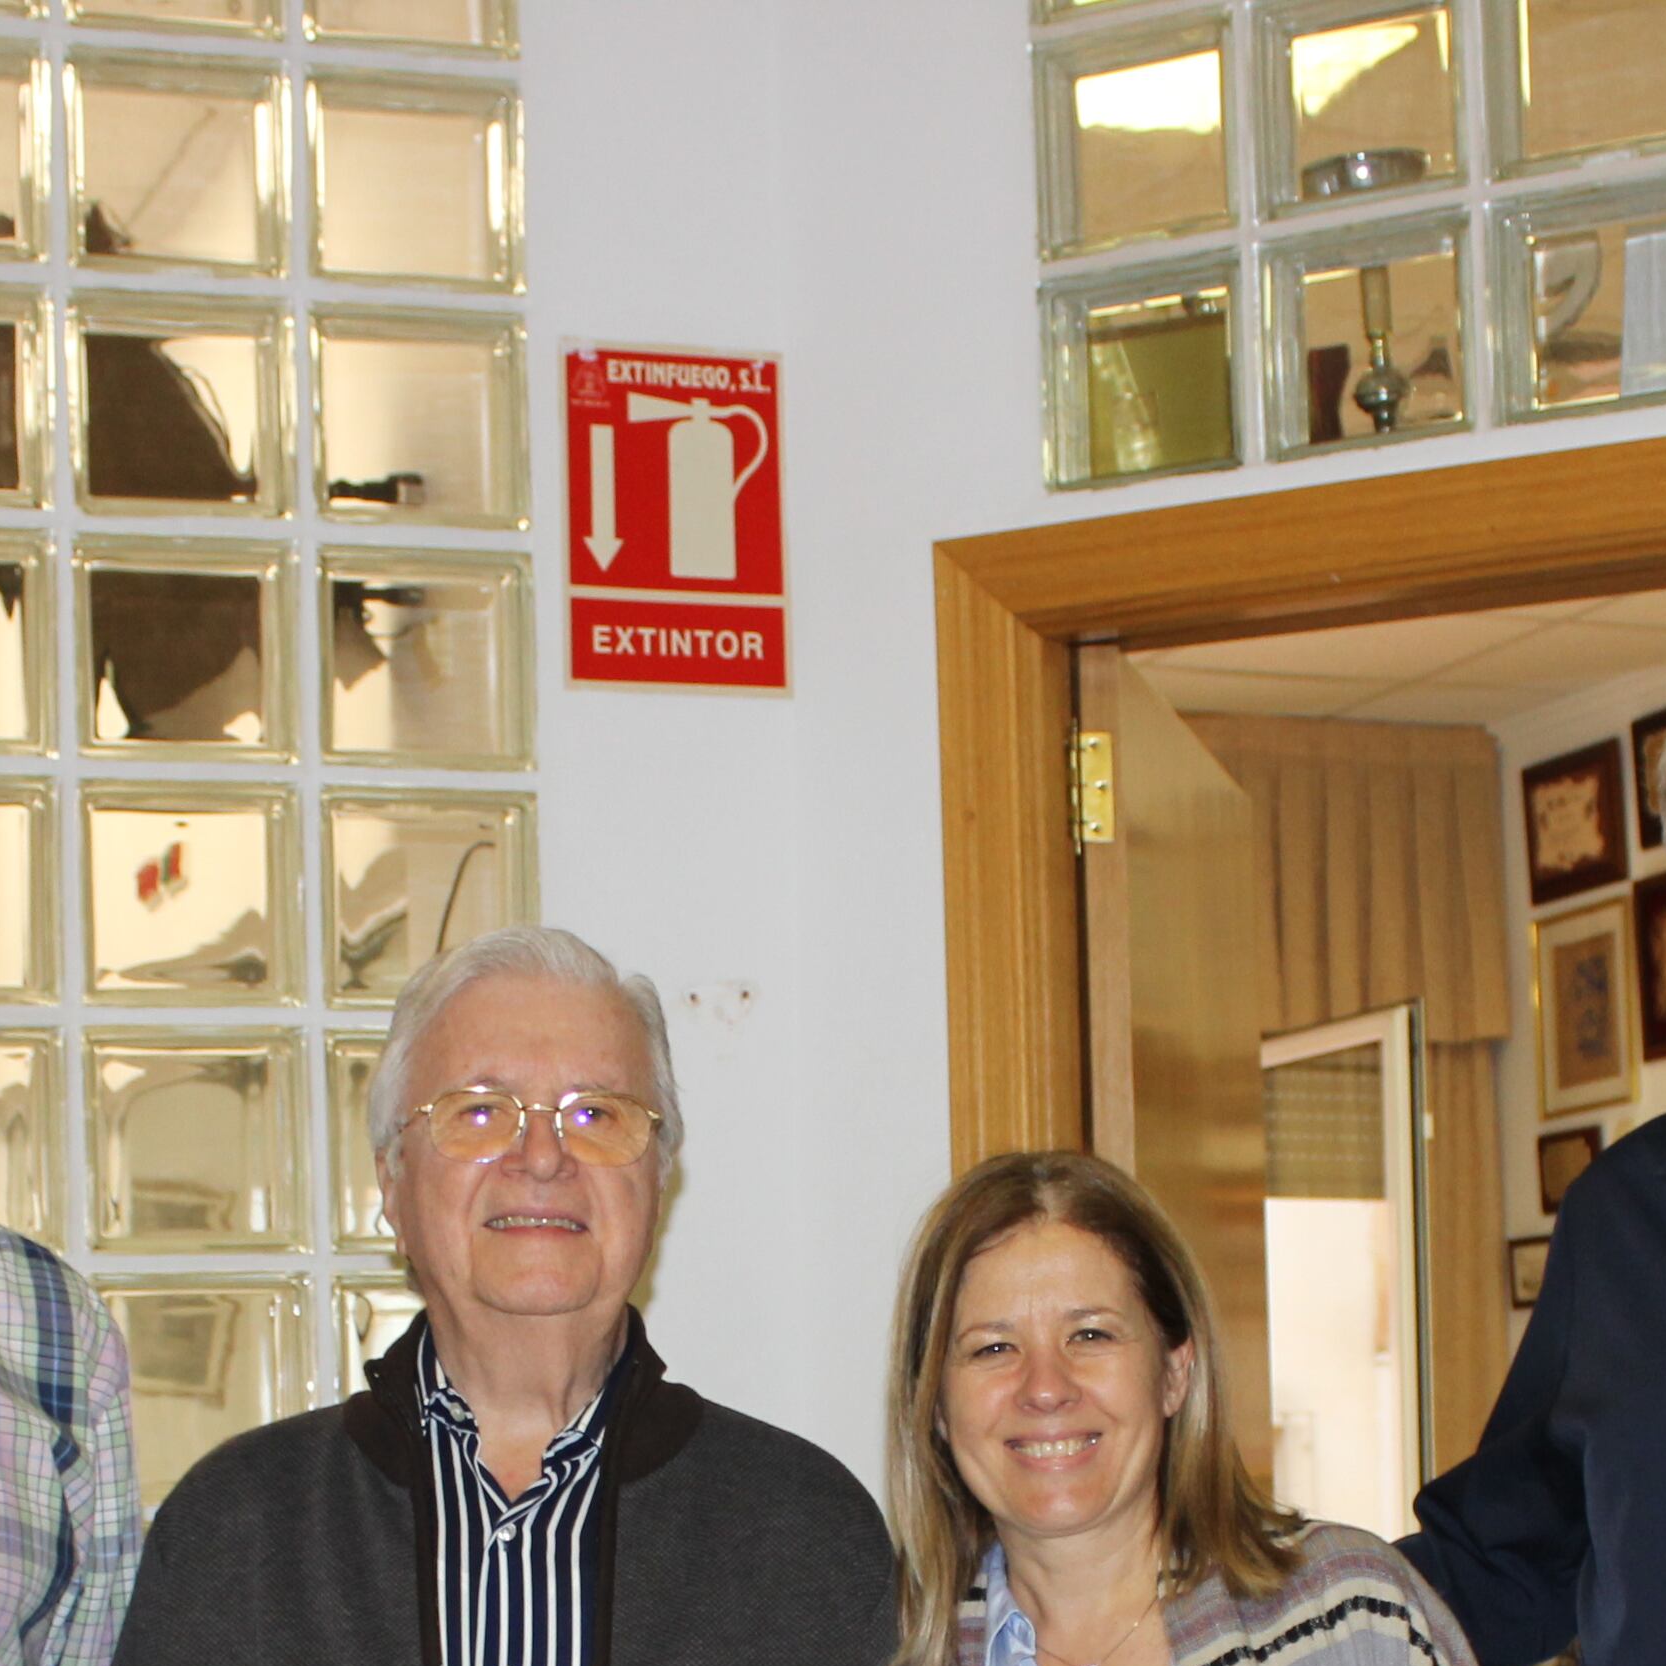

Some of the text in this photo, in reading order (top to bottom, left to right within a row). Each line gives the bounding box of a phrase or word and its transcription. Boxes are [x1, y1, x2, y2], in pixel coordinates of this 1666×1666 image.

[606, 358, 772, 394] EXTINFUEGO, S.L.
[591, 624, 765, 661] EXTINTOR
